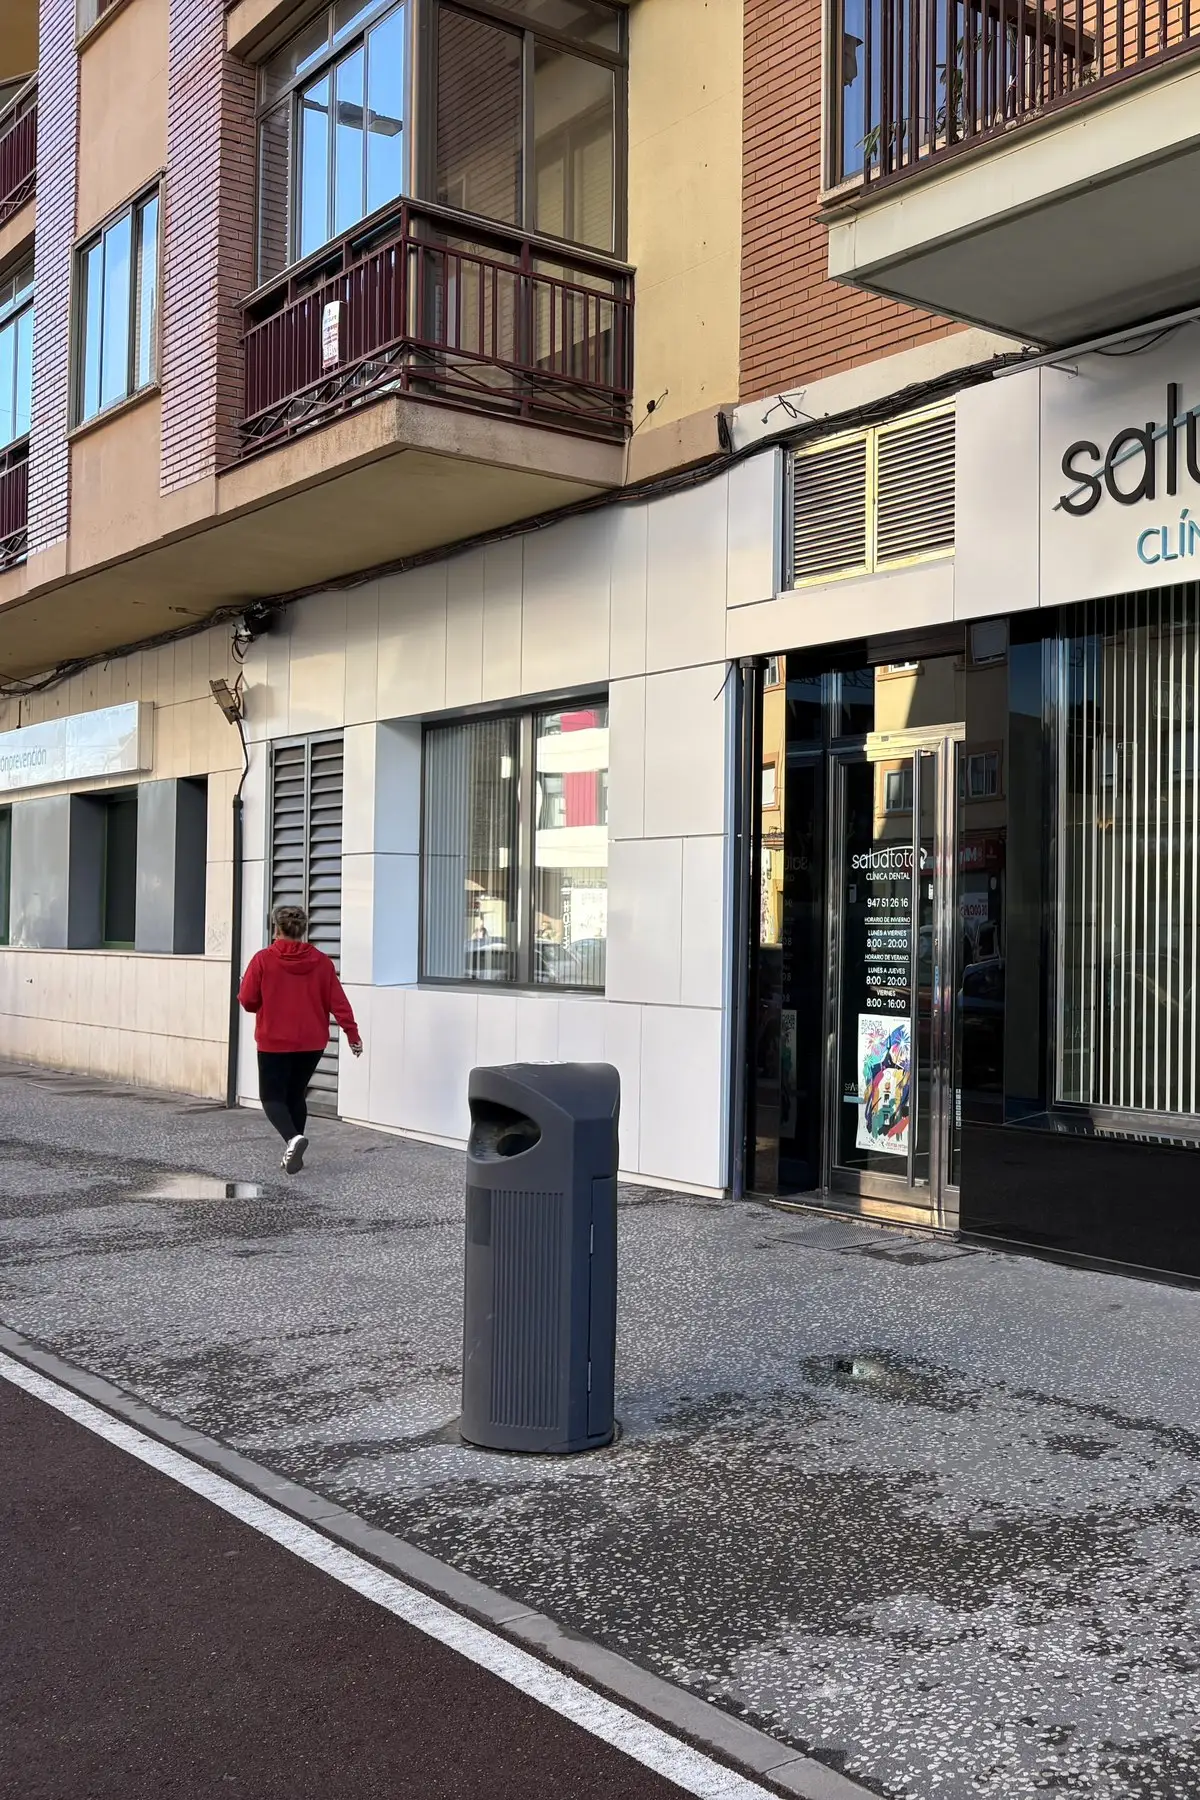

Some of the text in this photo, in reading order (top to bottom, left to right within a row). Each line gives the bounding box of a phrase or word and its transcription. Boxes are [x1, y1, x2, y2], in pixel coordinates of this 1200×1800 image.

[852, 847, 914, 869] saludtot
[866, 872, 910, 880] CLÍNICA DENTAL
[867, 898, 908, 907] 947 51 26 16
[866, 939, 881, 948] 8:00
[888, 939, 908, 948] 20:00
[866, 976, 881, 985] 8:00
[887, 976, 907, 986] 20:00
[866, 998, 882, 1007] 8:00
[888, 999, 906, 1009] 16:00
